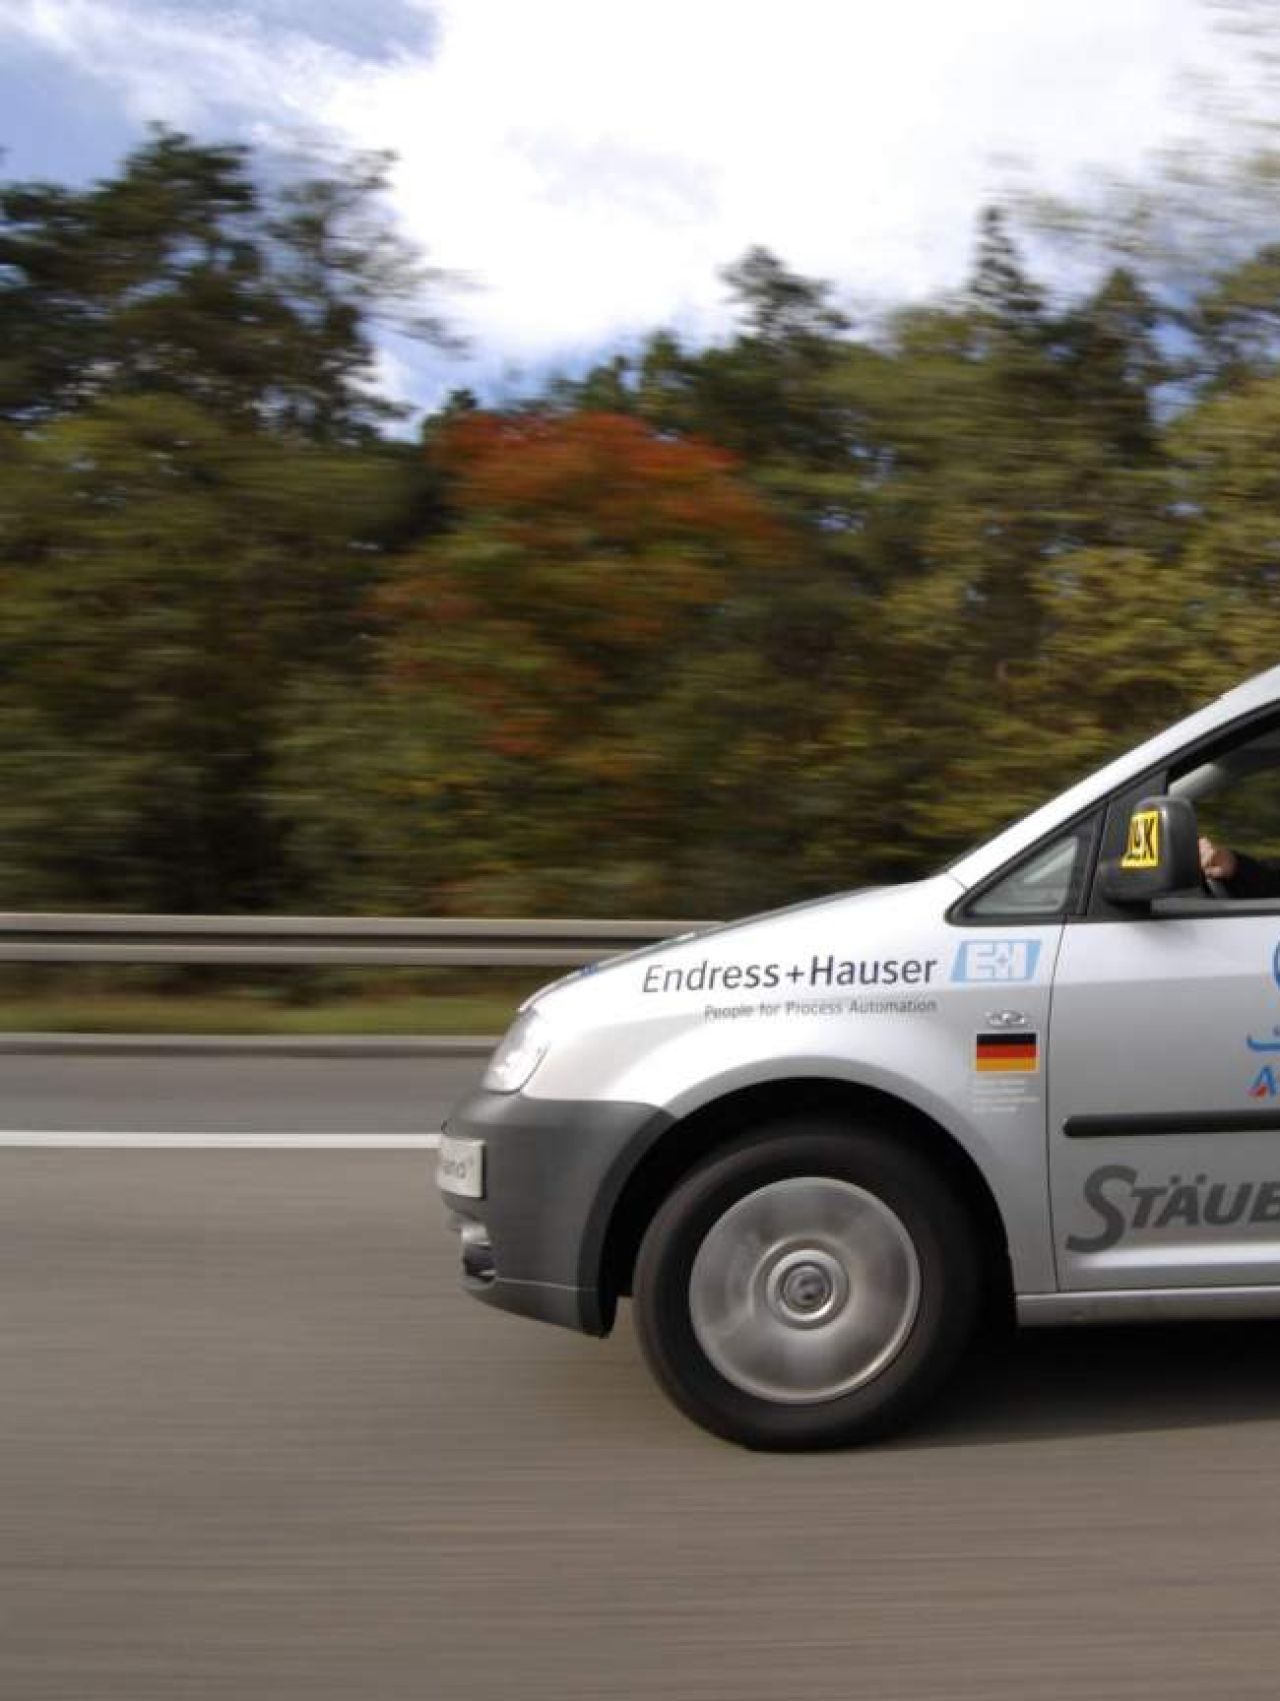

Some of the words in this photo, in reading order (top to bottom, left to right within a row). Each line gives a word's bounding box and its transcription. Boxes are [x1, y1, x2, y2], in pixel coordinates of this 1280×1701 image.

[643, 955, 938, 993] Endress+Hauser
[759, 1000, 780, 1017] for
[785, 999, 842, 1016] Process
[848, 998, 937, 1014] Automation
